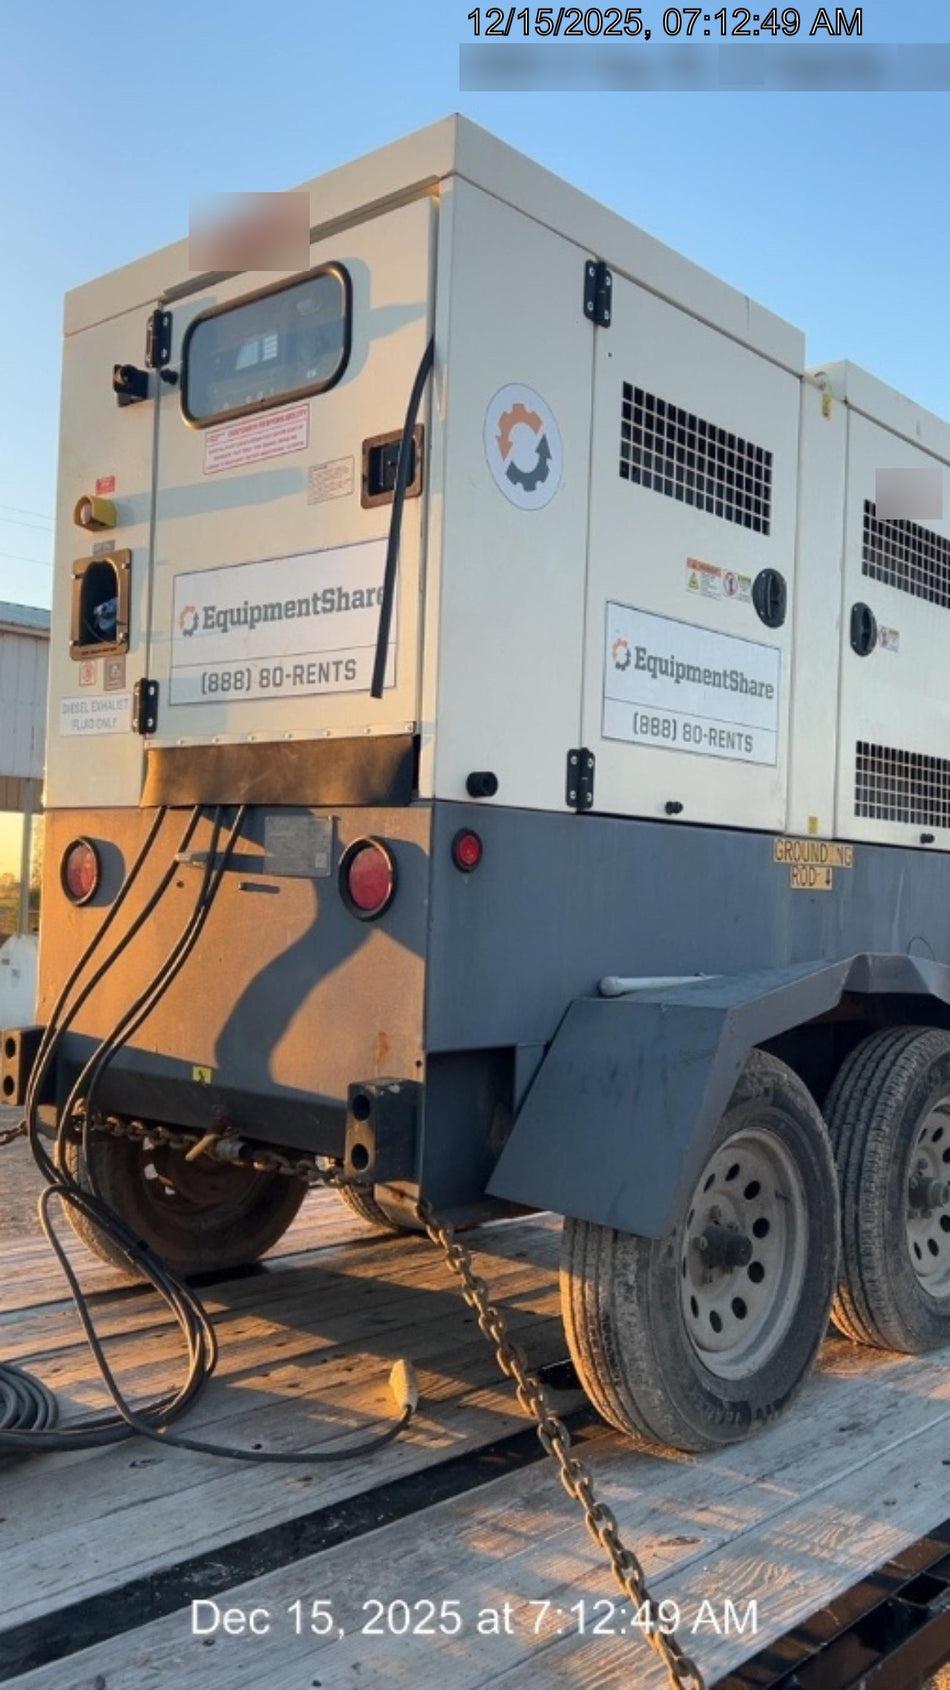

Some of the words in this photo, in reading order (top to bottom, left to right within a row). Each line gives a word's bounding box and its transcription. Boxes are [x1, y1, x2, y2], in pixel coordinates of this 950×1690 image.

[202, 667, 251, 695] (888)
[258, 658, 357, 688] 80-RENTS
[634, 645, 775, 700] EquipmentShare
[62, 701, 89, 715] DIESEL
[95, 717, 118, 729] ONLY
[633, 711, 677, 742] (888)
[682, 722, 754, 753] 80-RENTS
[775, 839, 853, 866] GROUNDNG
